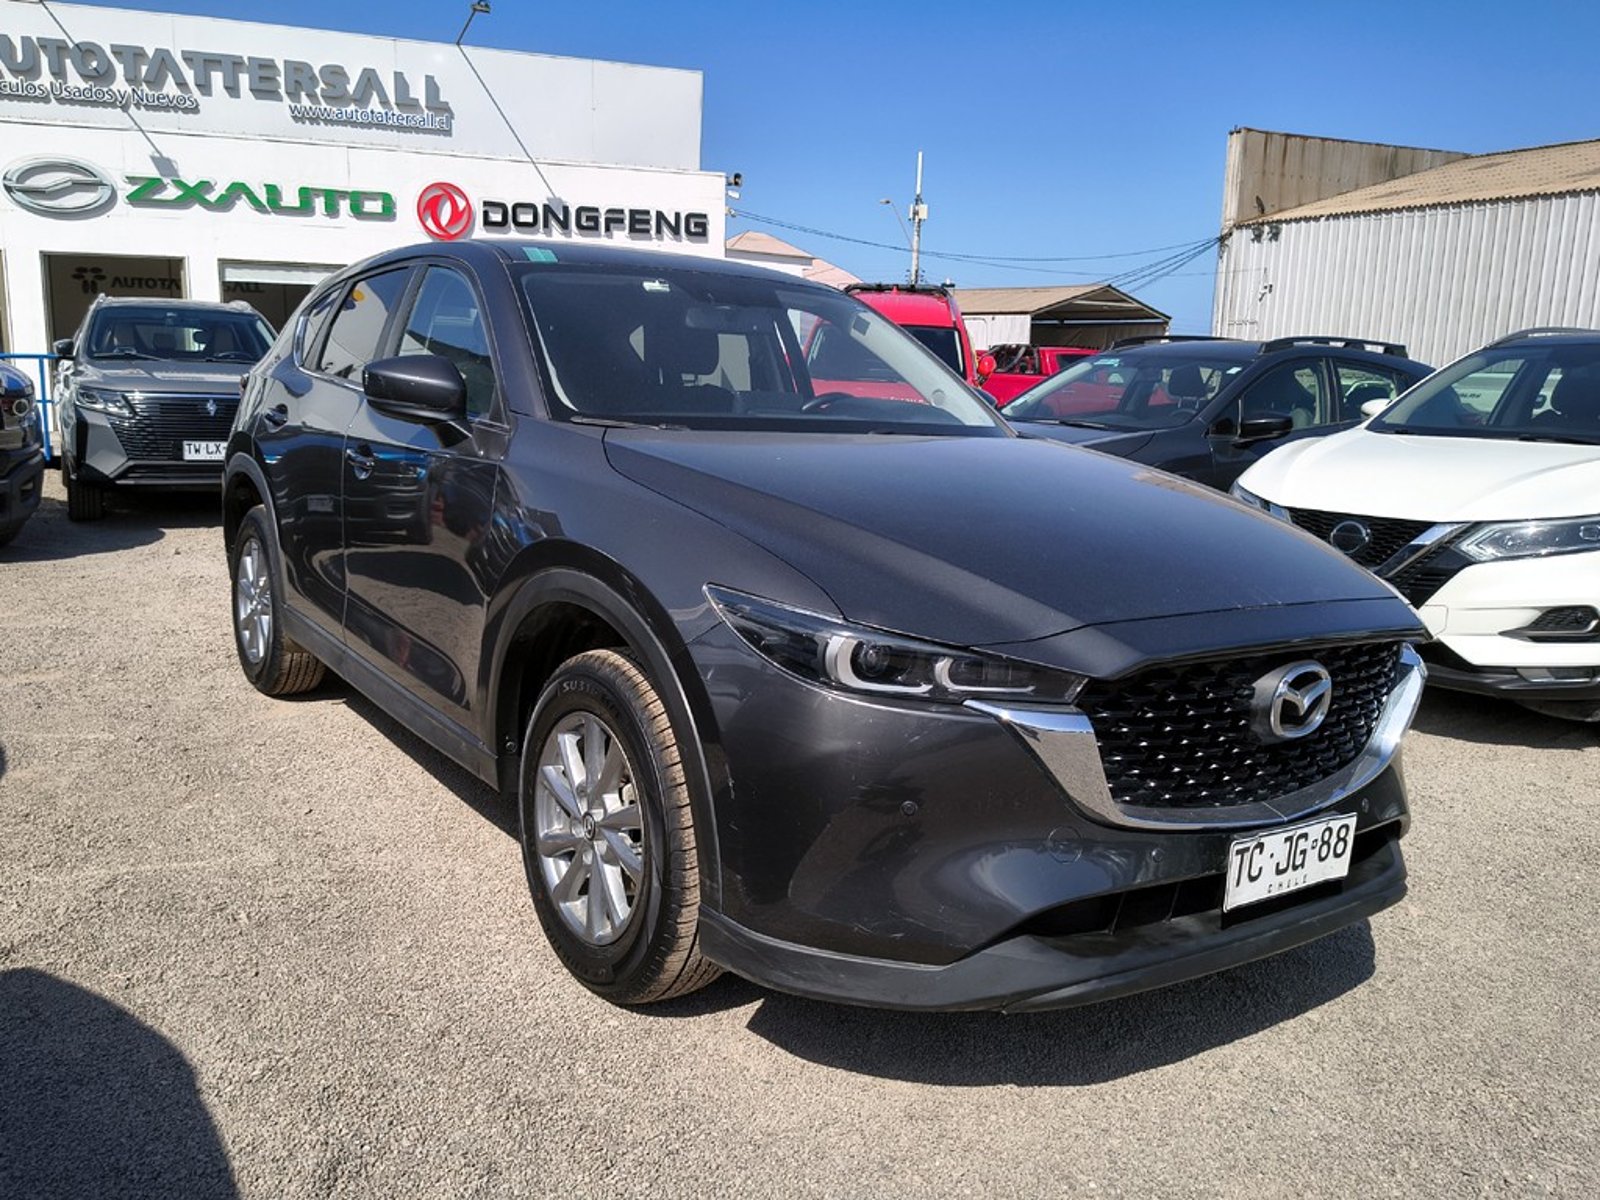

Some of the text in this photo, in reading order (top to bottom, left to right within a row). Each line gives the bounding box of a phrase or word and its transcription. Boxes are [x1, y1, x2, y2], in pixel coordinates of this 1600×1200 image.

[50, 81, 114, 101] Usados
[116, 87, 127, 105] y
[132, 87, 198, 108] Nuevos
[288, 104, 450, 130] www.autotattersall.cl
[125, 175, 395, 217] ZXAUTO
[482, 199, 708, 237] DONGFENG
